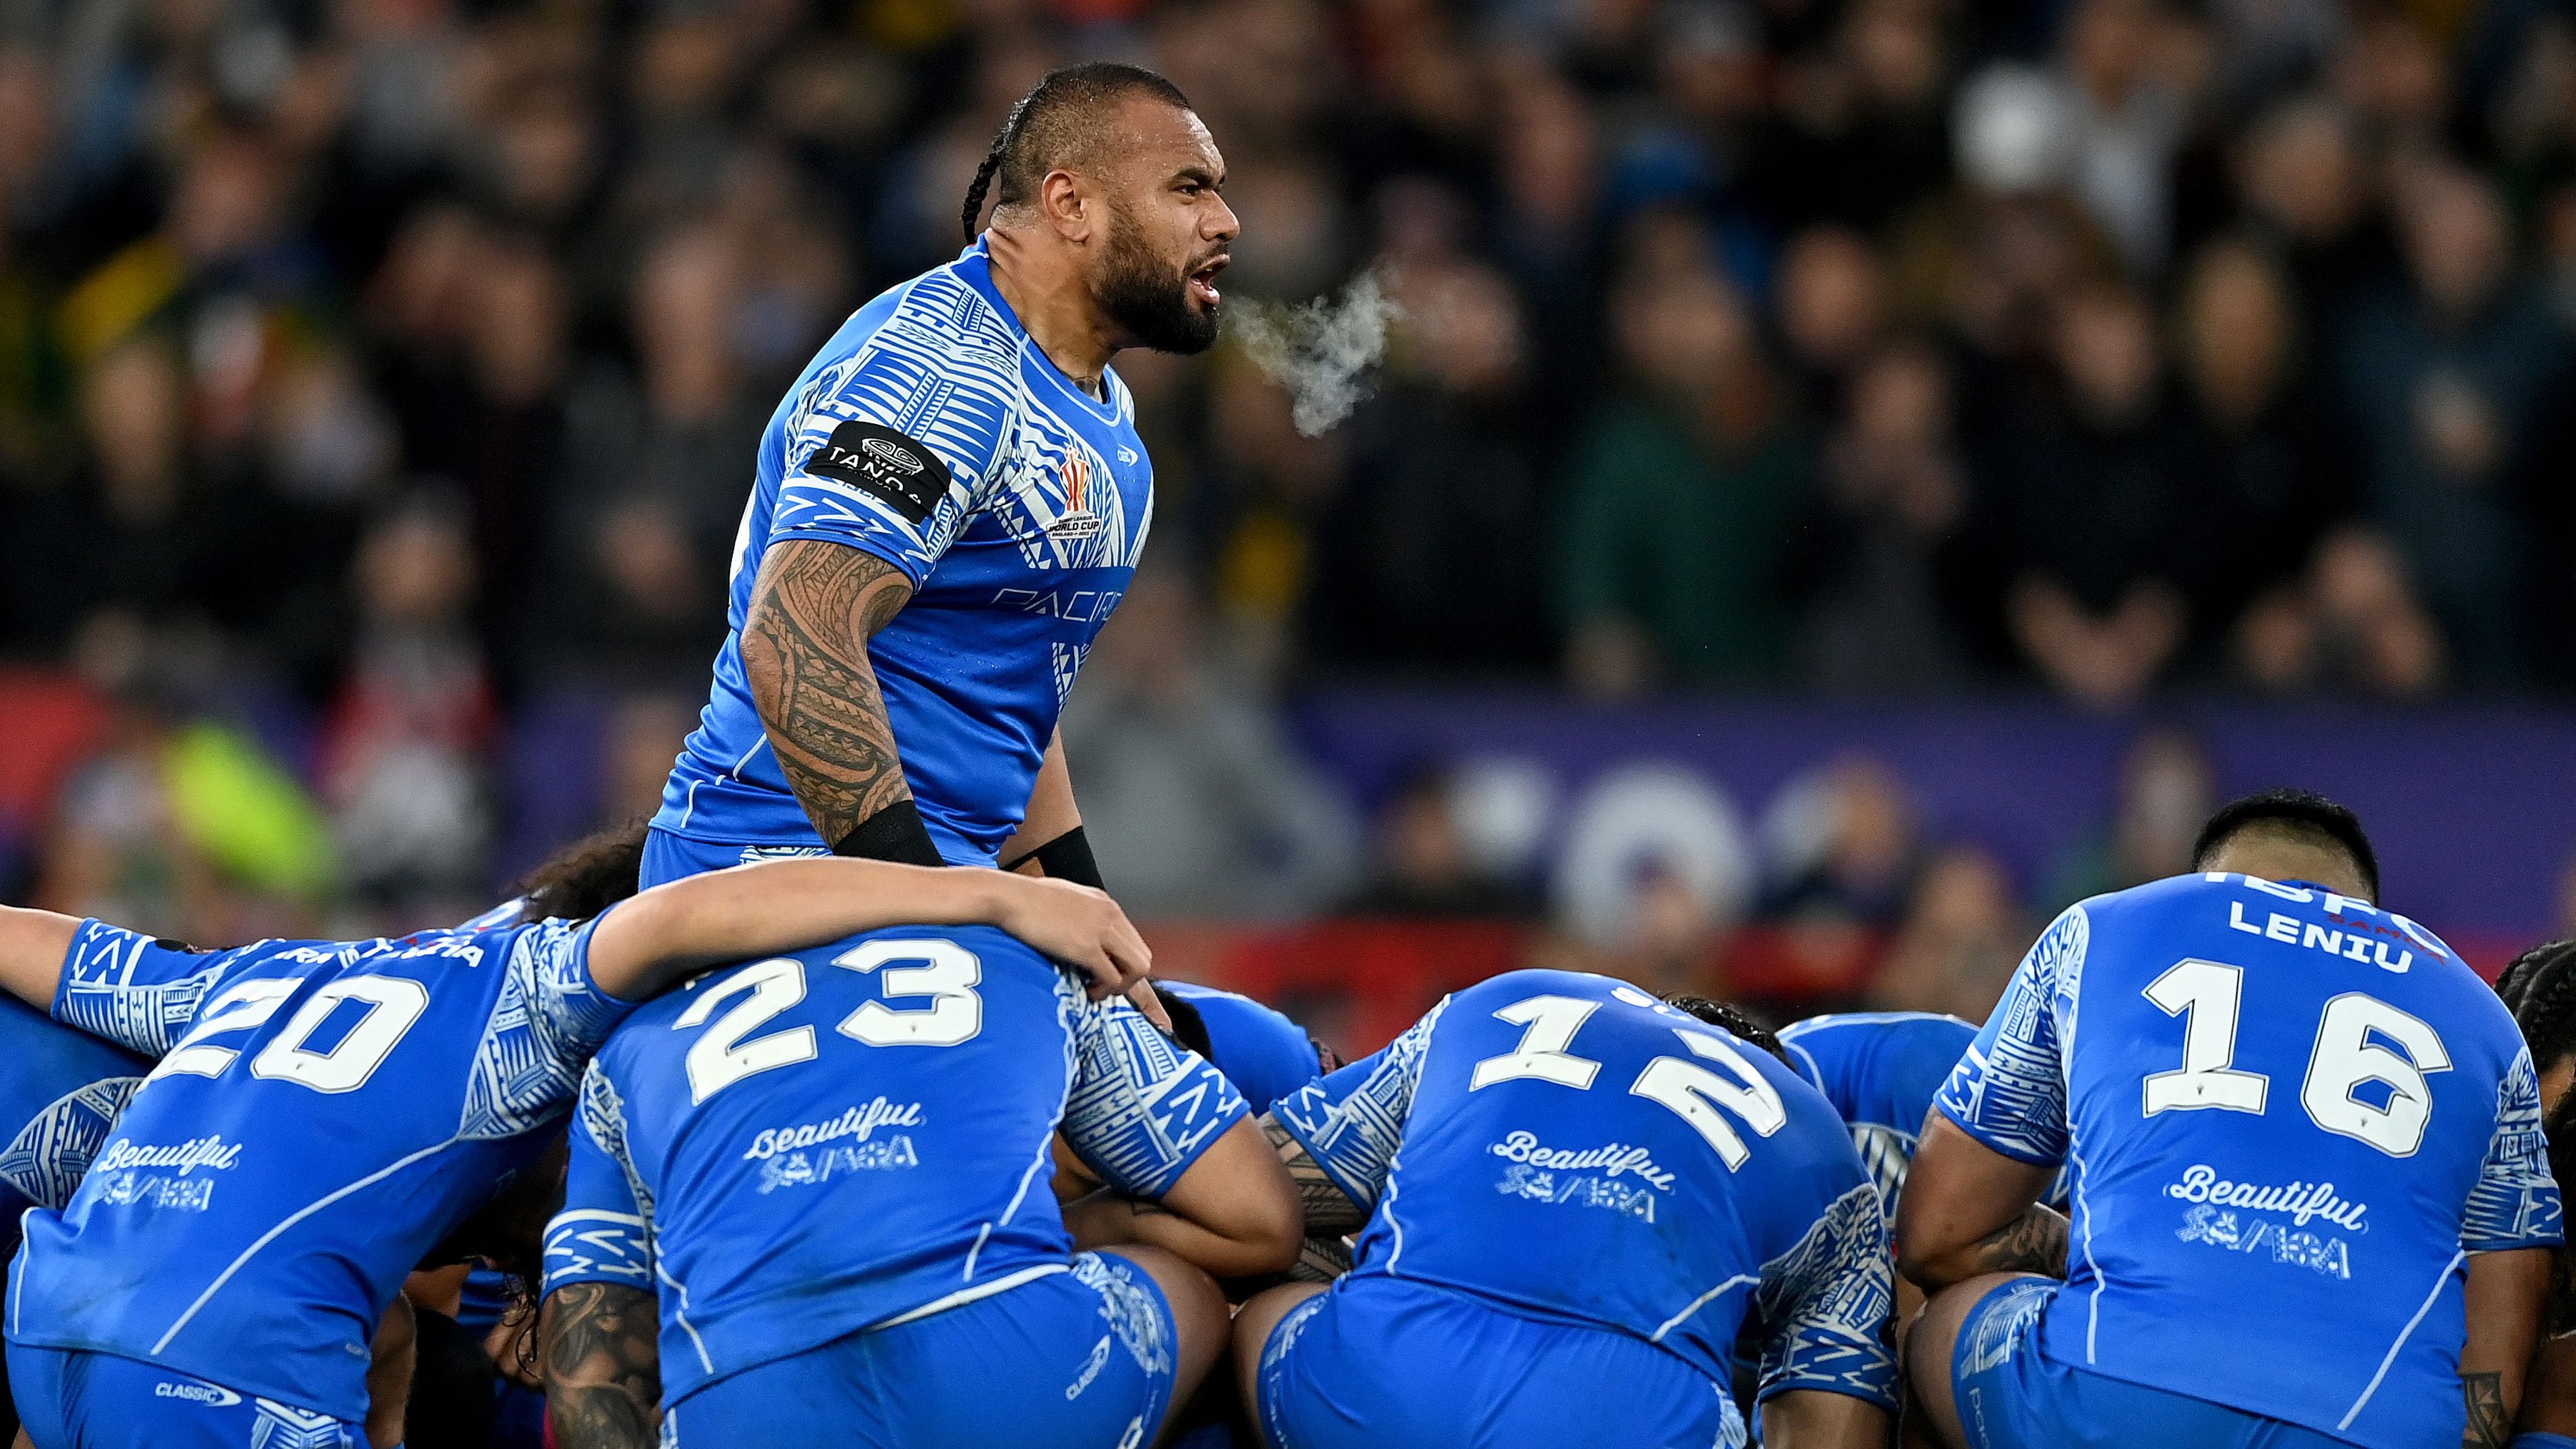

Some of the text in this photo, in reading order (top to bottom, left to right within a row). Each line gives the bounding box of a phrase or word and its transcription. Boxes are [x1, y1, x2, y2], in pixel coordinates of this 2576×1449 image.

[1049, 521, 1100, 532] WORLD CUP
[2229, 900, 2414, 973] LENIU
[139, 973, 430, 1094] 20
[671, 938, 983, 1107] 23
[1468, 993, 1787, 1174] 12
[2141, 957, 2454, 1159] 16
[97, 1134, 243, 1177] Beautiful
[742, 1095, 922, 1160] Beautiful
[1492, 1129, 1677, 1191] Beautiful
[2169, 1164, 2367, 1230] Beautiful
[155, 1382, 218, 1403] CLASSIC
